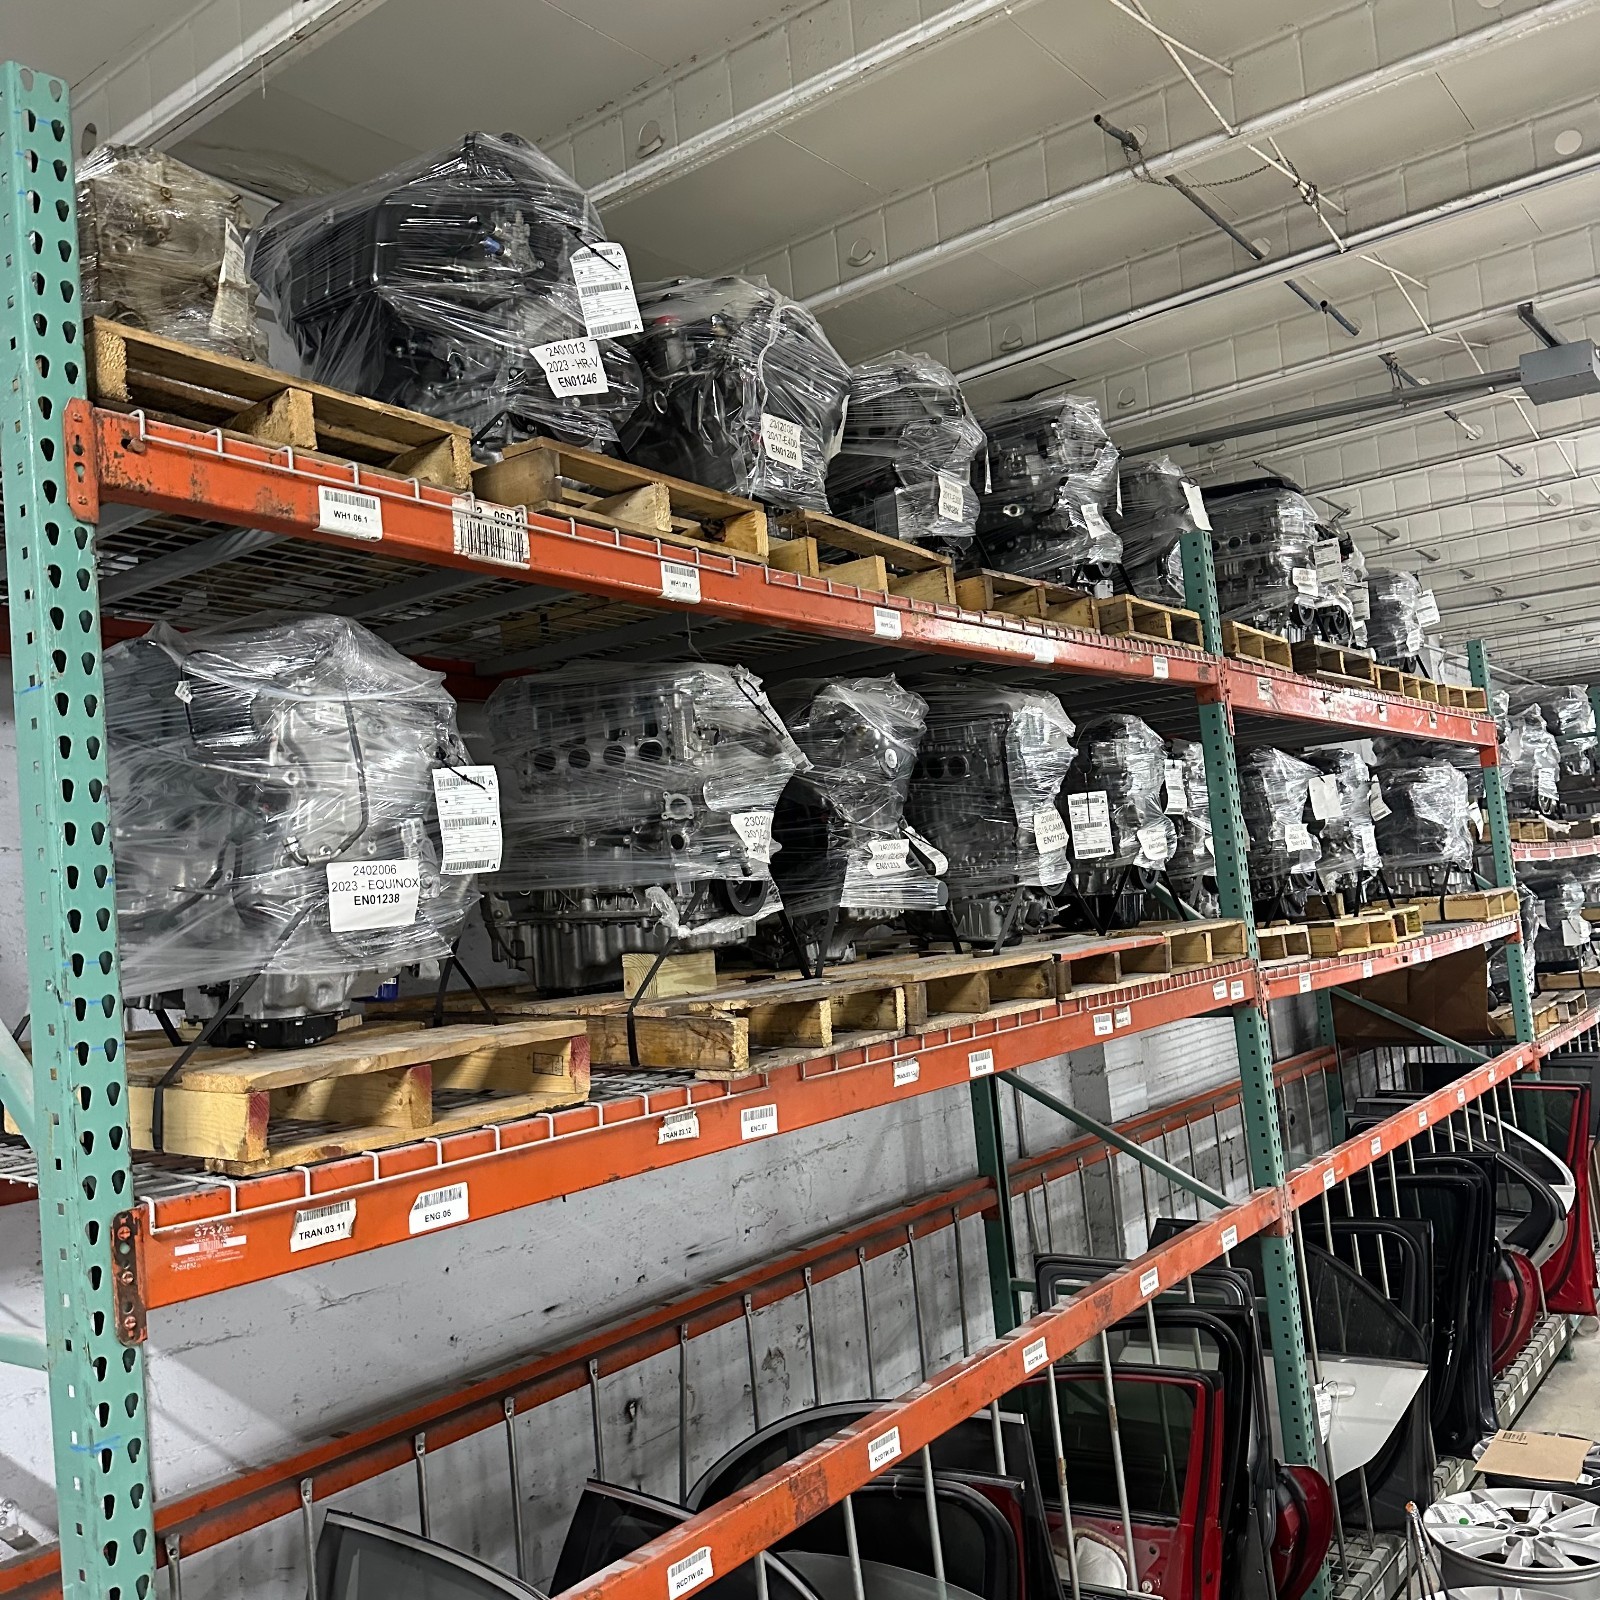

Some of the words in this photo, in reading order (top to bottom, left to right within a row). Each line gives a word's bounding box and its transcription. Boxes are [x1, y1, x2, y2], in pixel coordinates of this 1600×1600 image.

[546, 342, 586, 357] 2401013
[547, 359, 569, 373] 2023
[576, 355, 600, 369] HR-V
[558, 373, 598, 388] EN01246
[333, 510, 368, 524] WH1.06.1
[352, 864, 397, 877] 2402006
[331, 881, 357, 893] 2023
[367, 877, 419, 891] EQUINOX
[353, 893, 400, 906] EN01238
[299, 1222, 346, 1241] TRAN.03.11
